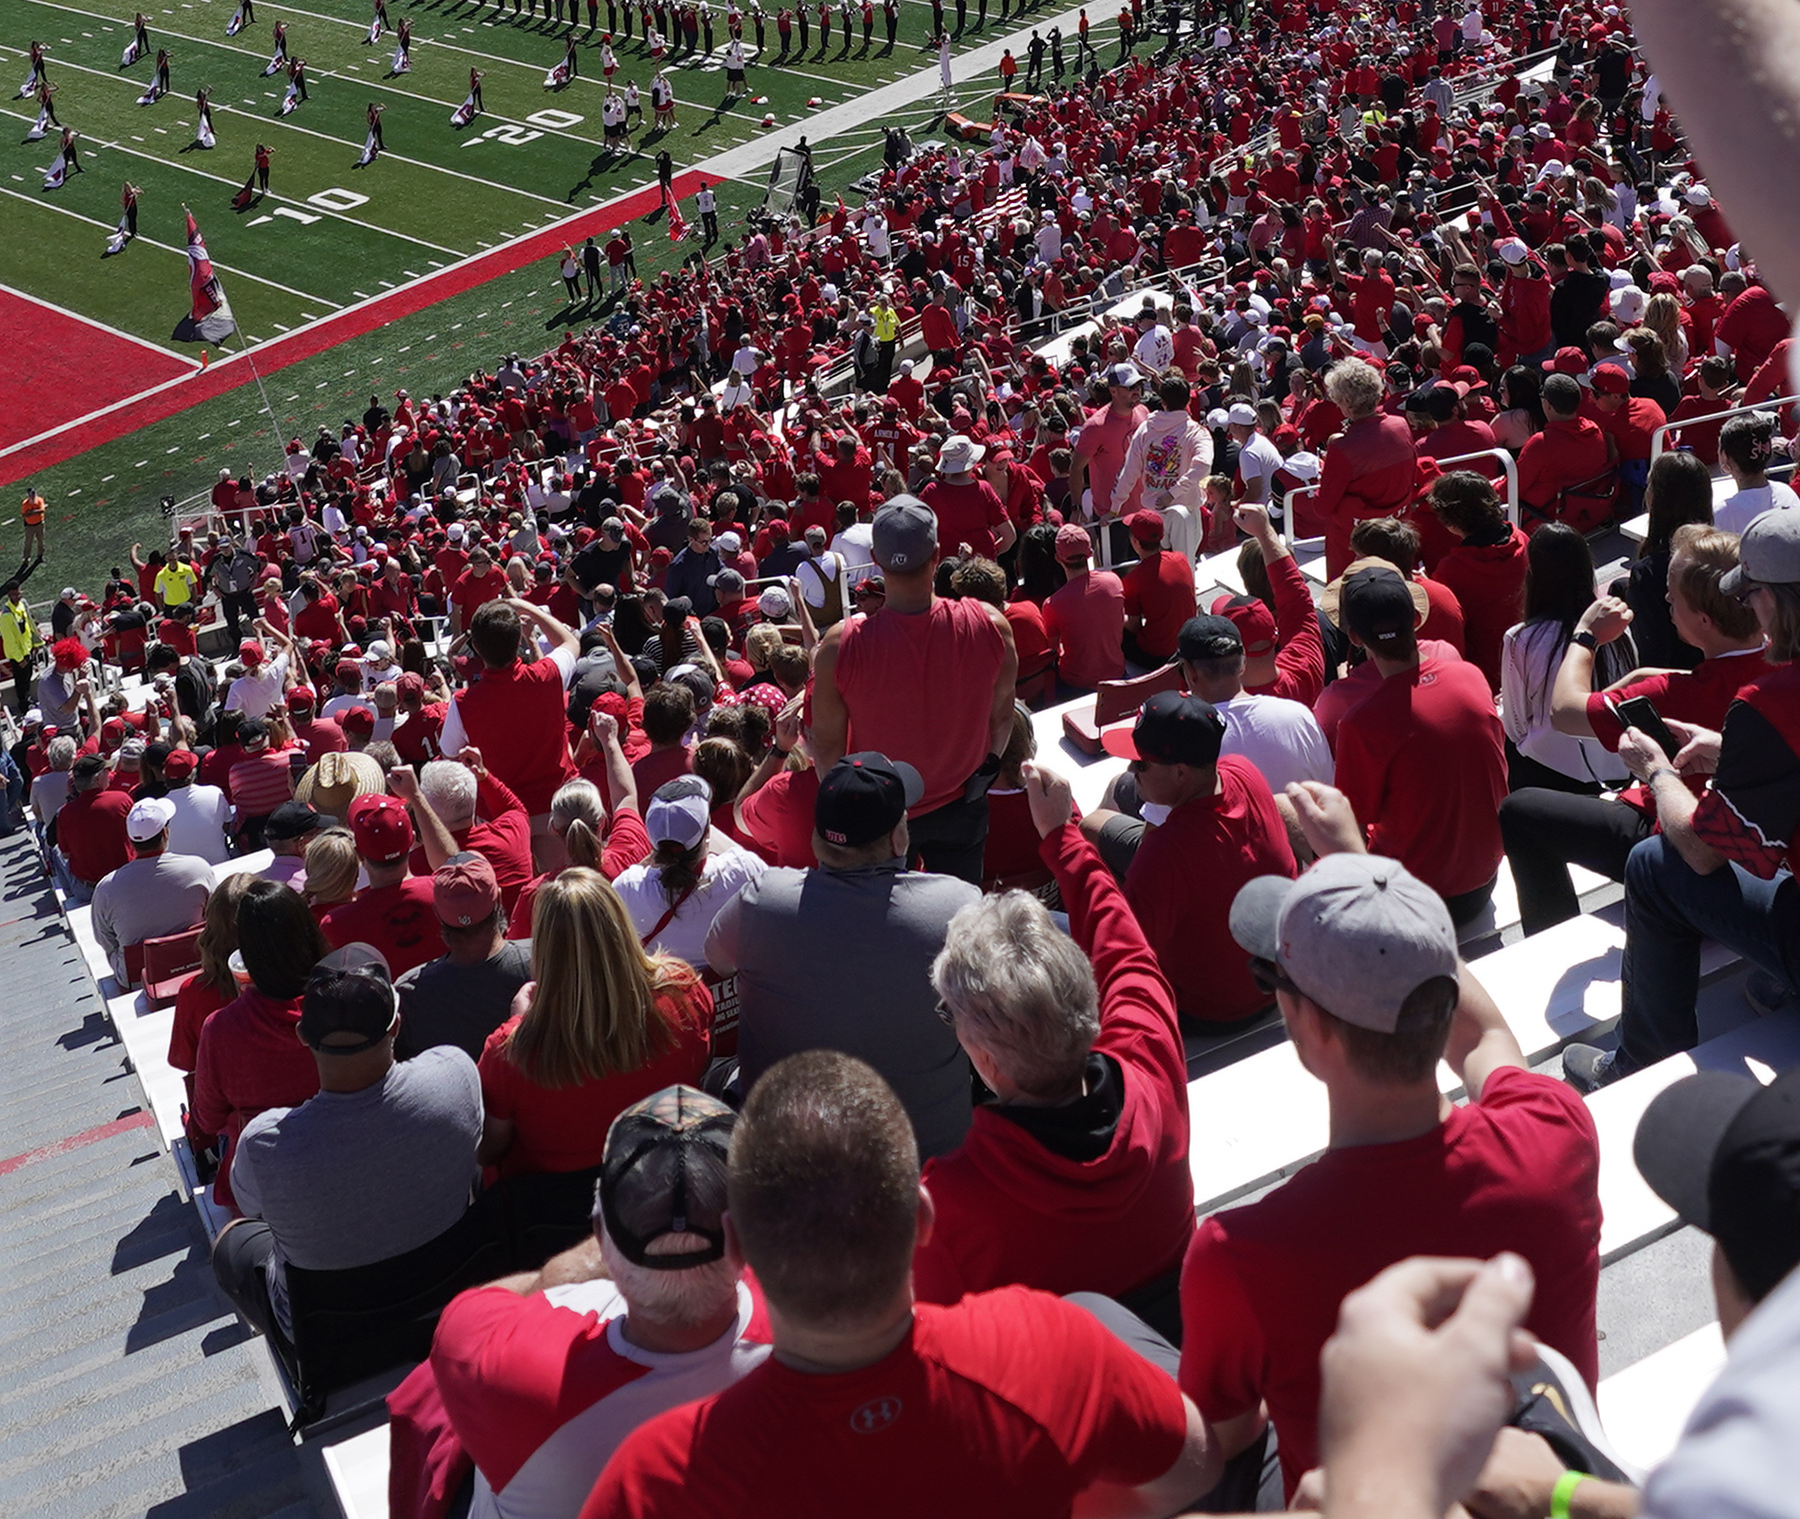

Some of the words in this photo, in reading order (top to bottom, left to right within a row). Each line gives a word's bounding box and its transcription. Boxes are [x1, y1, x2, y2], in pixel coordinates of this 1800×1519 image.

[480, 107, 585, 145] 20
[272, 187, 371, 224] 10
[957, 255, 970, 267] 15
[874, 429, 900, 439] ARNOLD
